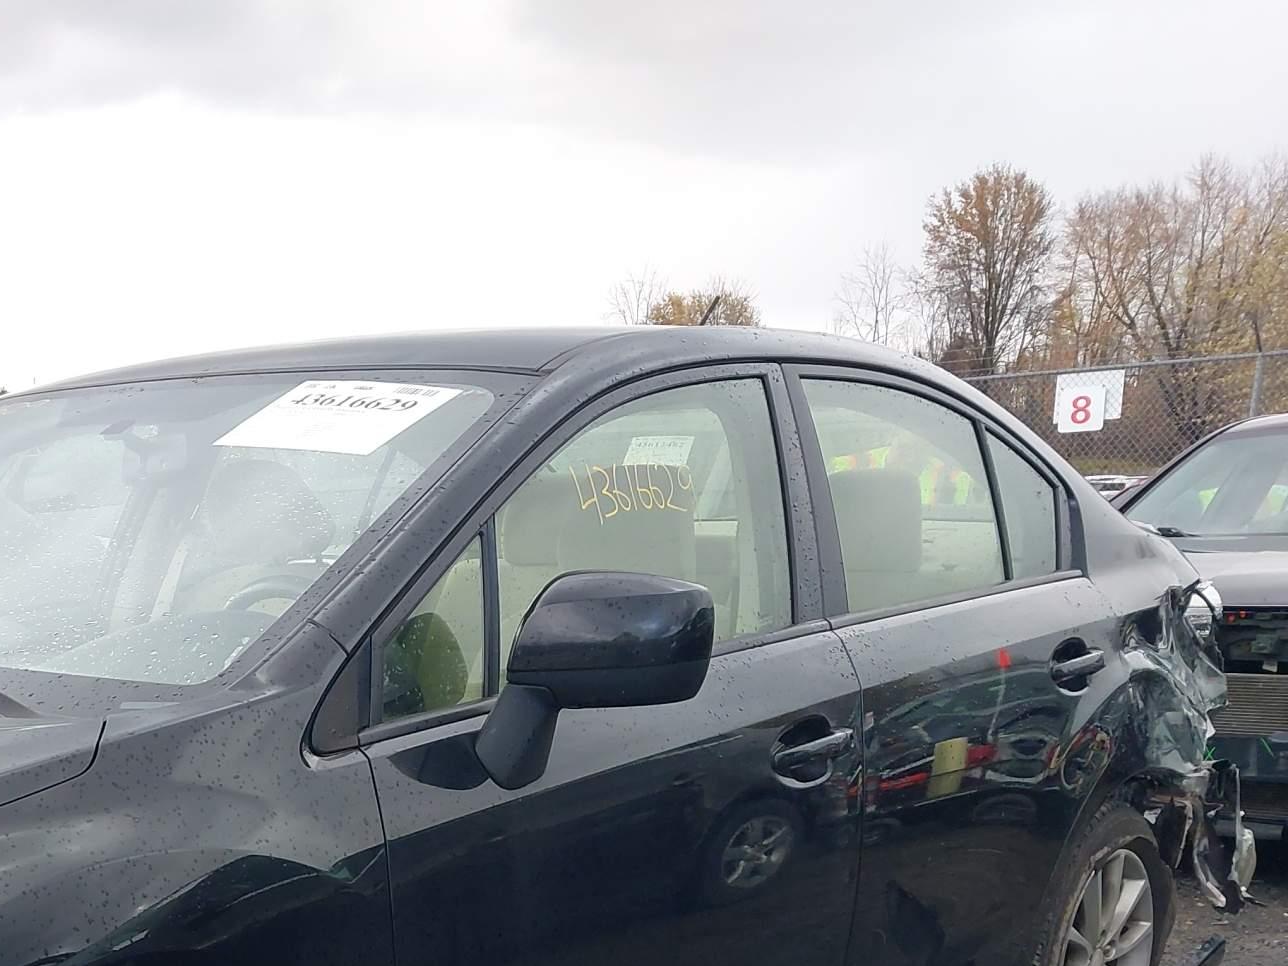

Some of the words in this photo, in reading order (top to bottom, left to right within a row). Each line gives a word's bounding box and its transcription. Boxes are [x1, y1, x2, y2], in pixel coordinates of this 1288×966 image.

[291, 393, 419, 412] 43616629
[1070, 395, 1092, 425] 8
[568, 463, 698, 526] 43616629
